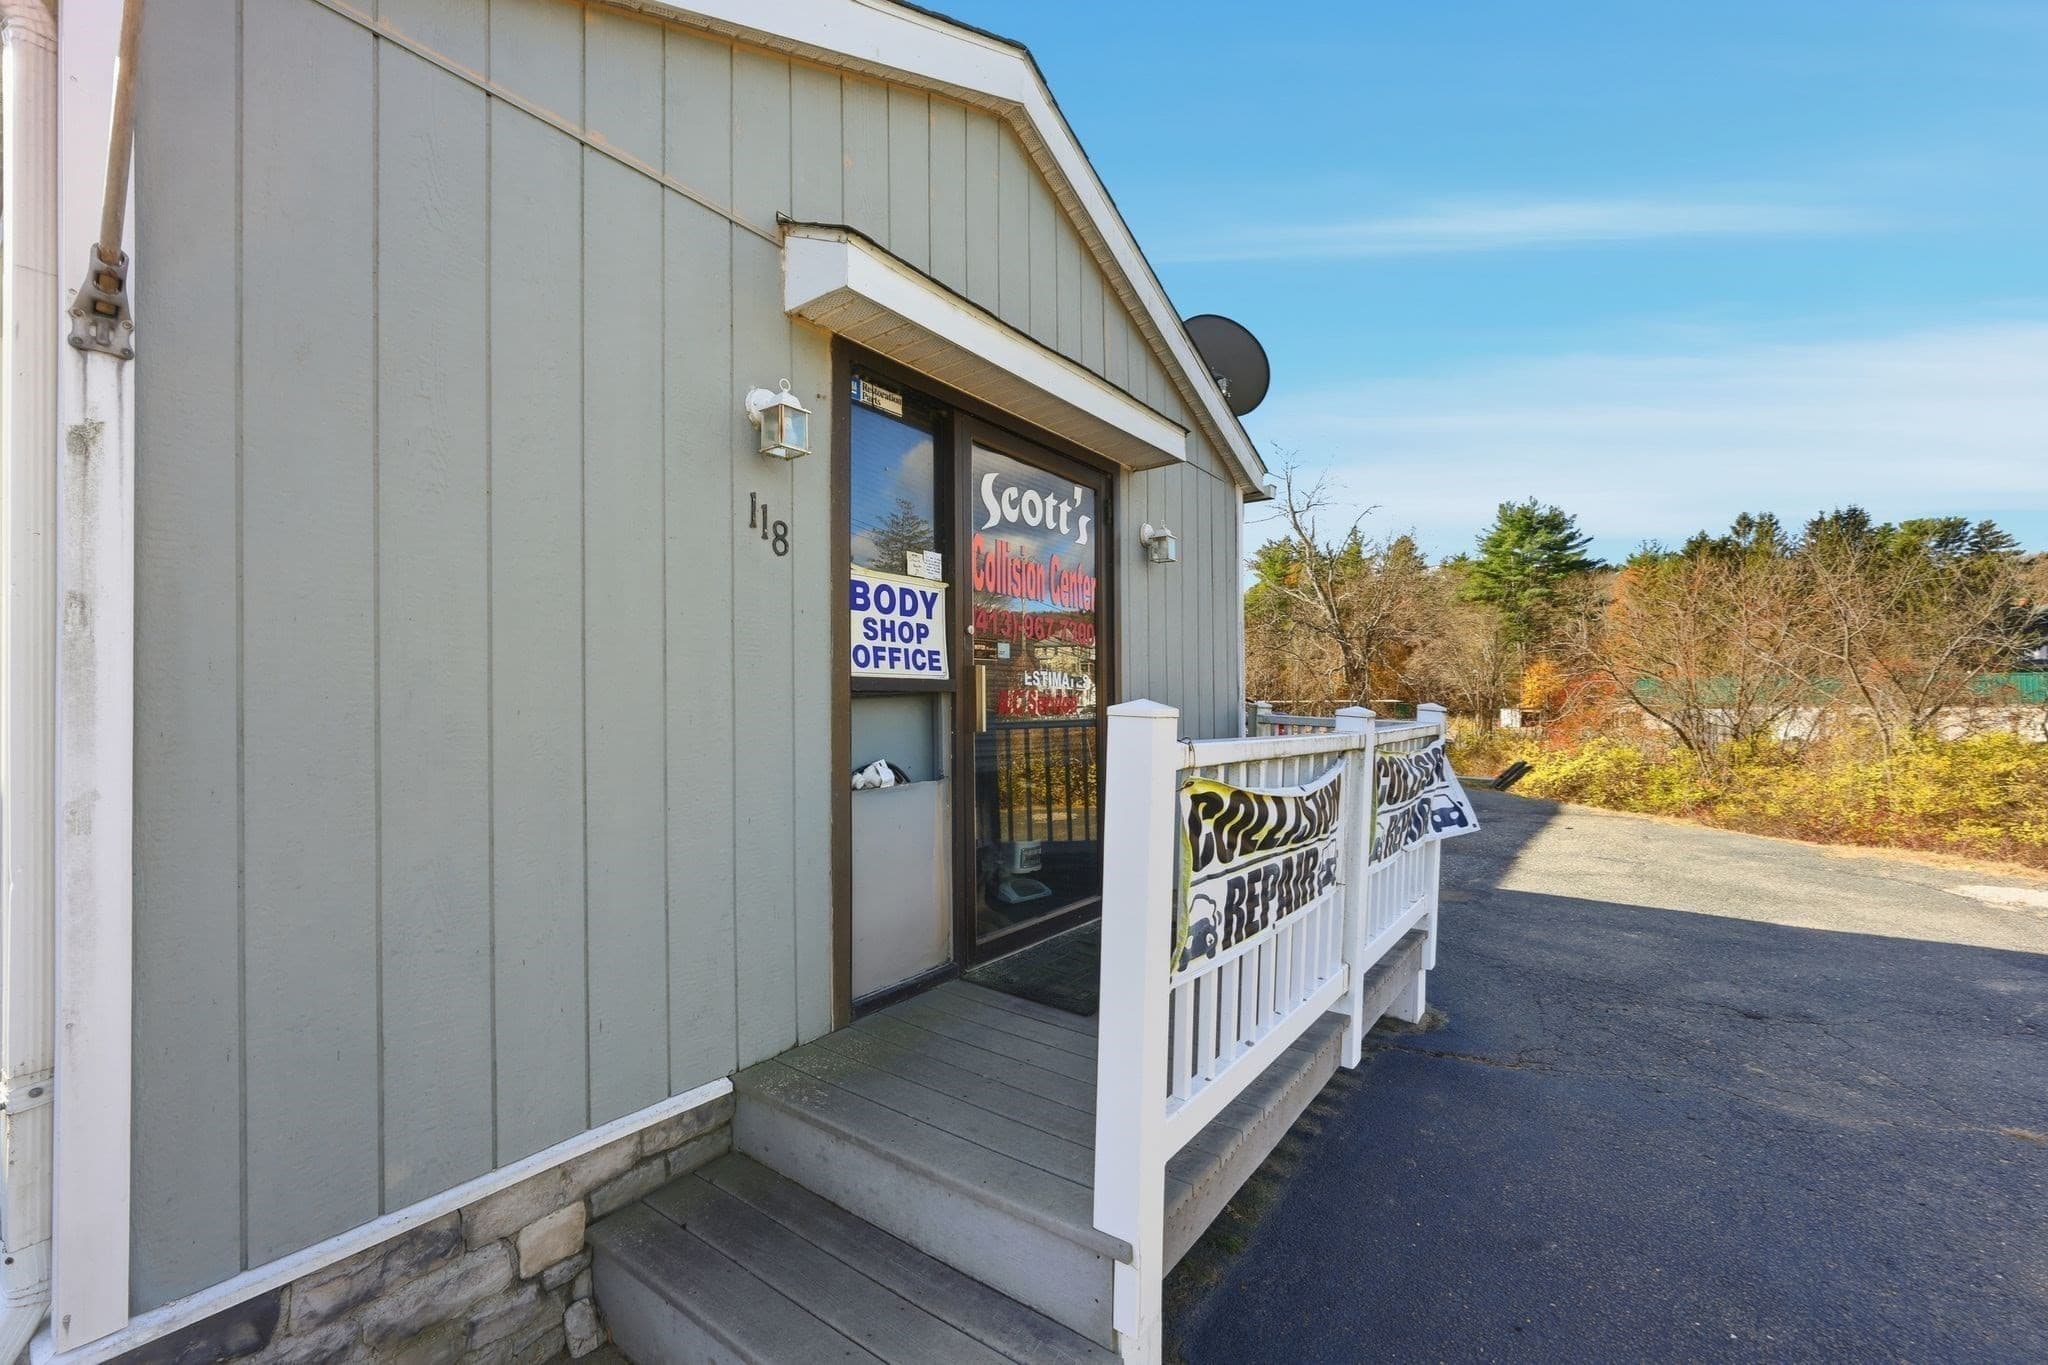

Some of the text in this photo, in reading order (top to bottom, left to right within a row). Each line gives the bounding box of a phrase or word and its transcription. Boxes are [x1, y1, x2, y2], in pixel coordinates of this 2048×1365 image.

[749, 491, 789, 557] 118
[981, 472, 1091, 545] Scott's
[850, 579, 938, 619] BODY
[972, 532, 1045, 601] Collision
[1049, 553, 1096, 611] Center
[852, 644, 942, 671] OFFICE
[863, 616, 929, 644] SHOP
[1222, 847, 1319, 951] REPAIR
